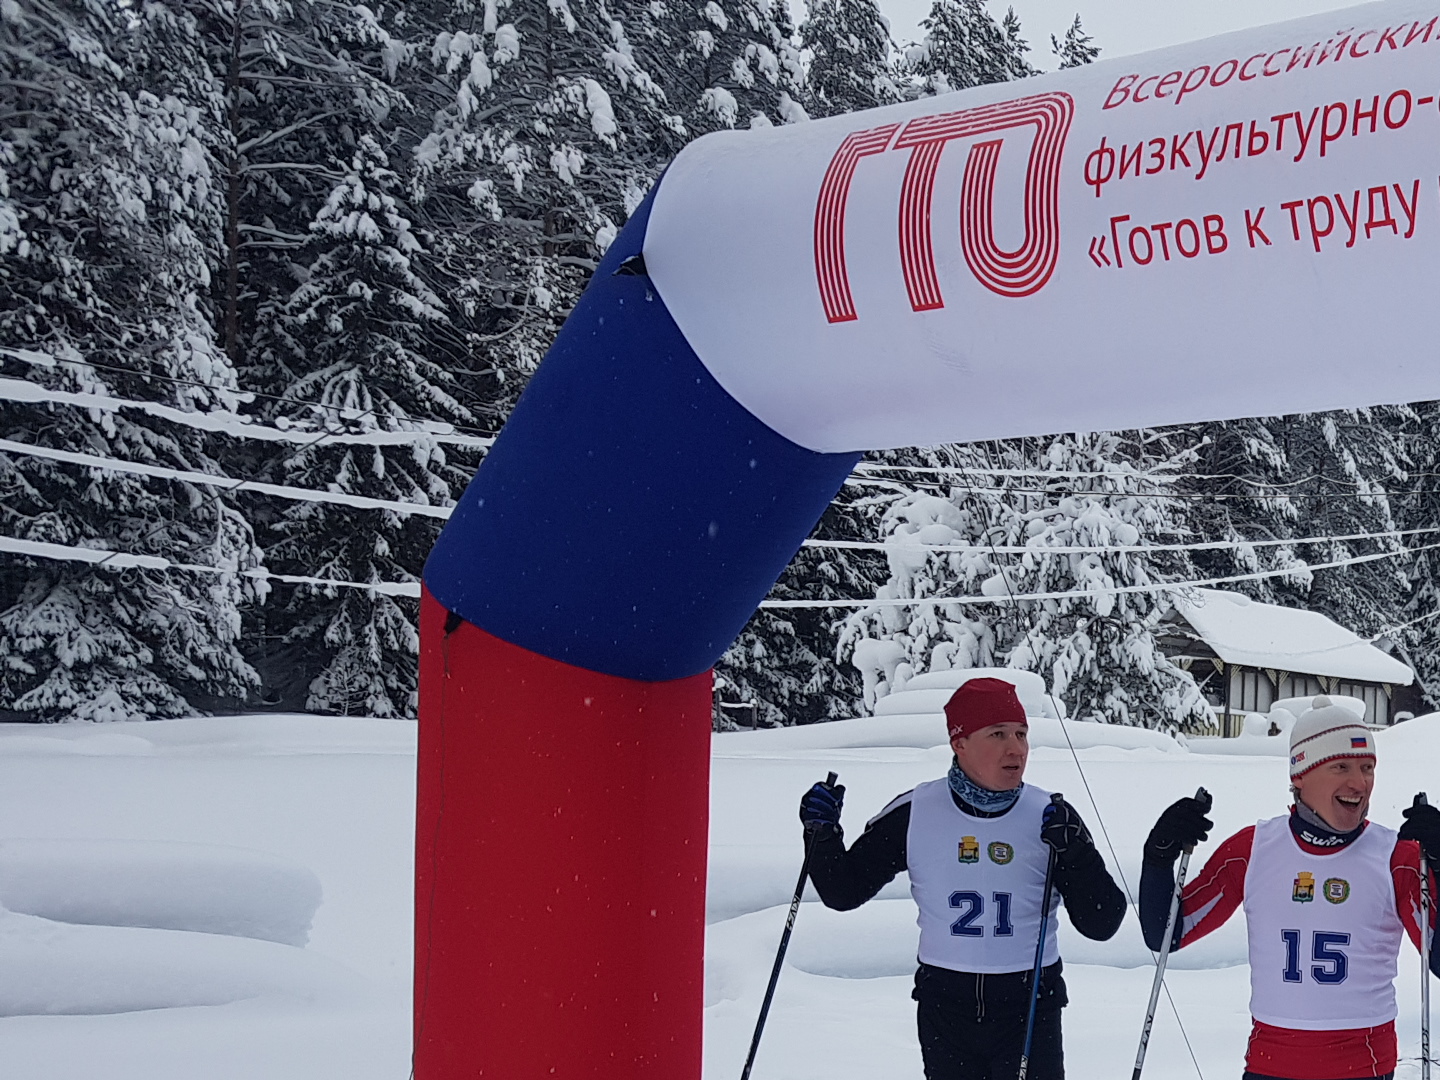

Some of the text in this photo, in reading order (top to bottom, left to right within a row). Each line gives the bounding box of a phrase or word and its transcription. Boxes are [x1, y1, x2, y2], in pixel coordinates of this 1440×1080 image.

[813, 91, 1075, 324] ГТО
[1088, 214, 1229, 269] «Готов
[1245, 207, 1272, 249] к
[1281, 181, 1419, 252] труду
[948, 890, 1014, 937] 21
[1281, 929, 1351, 985] 15
